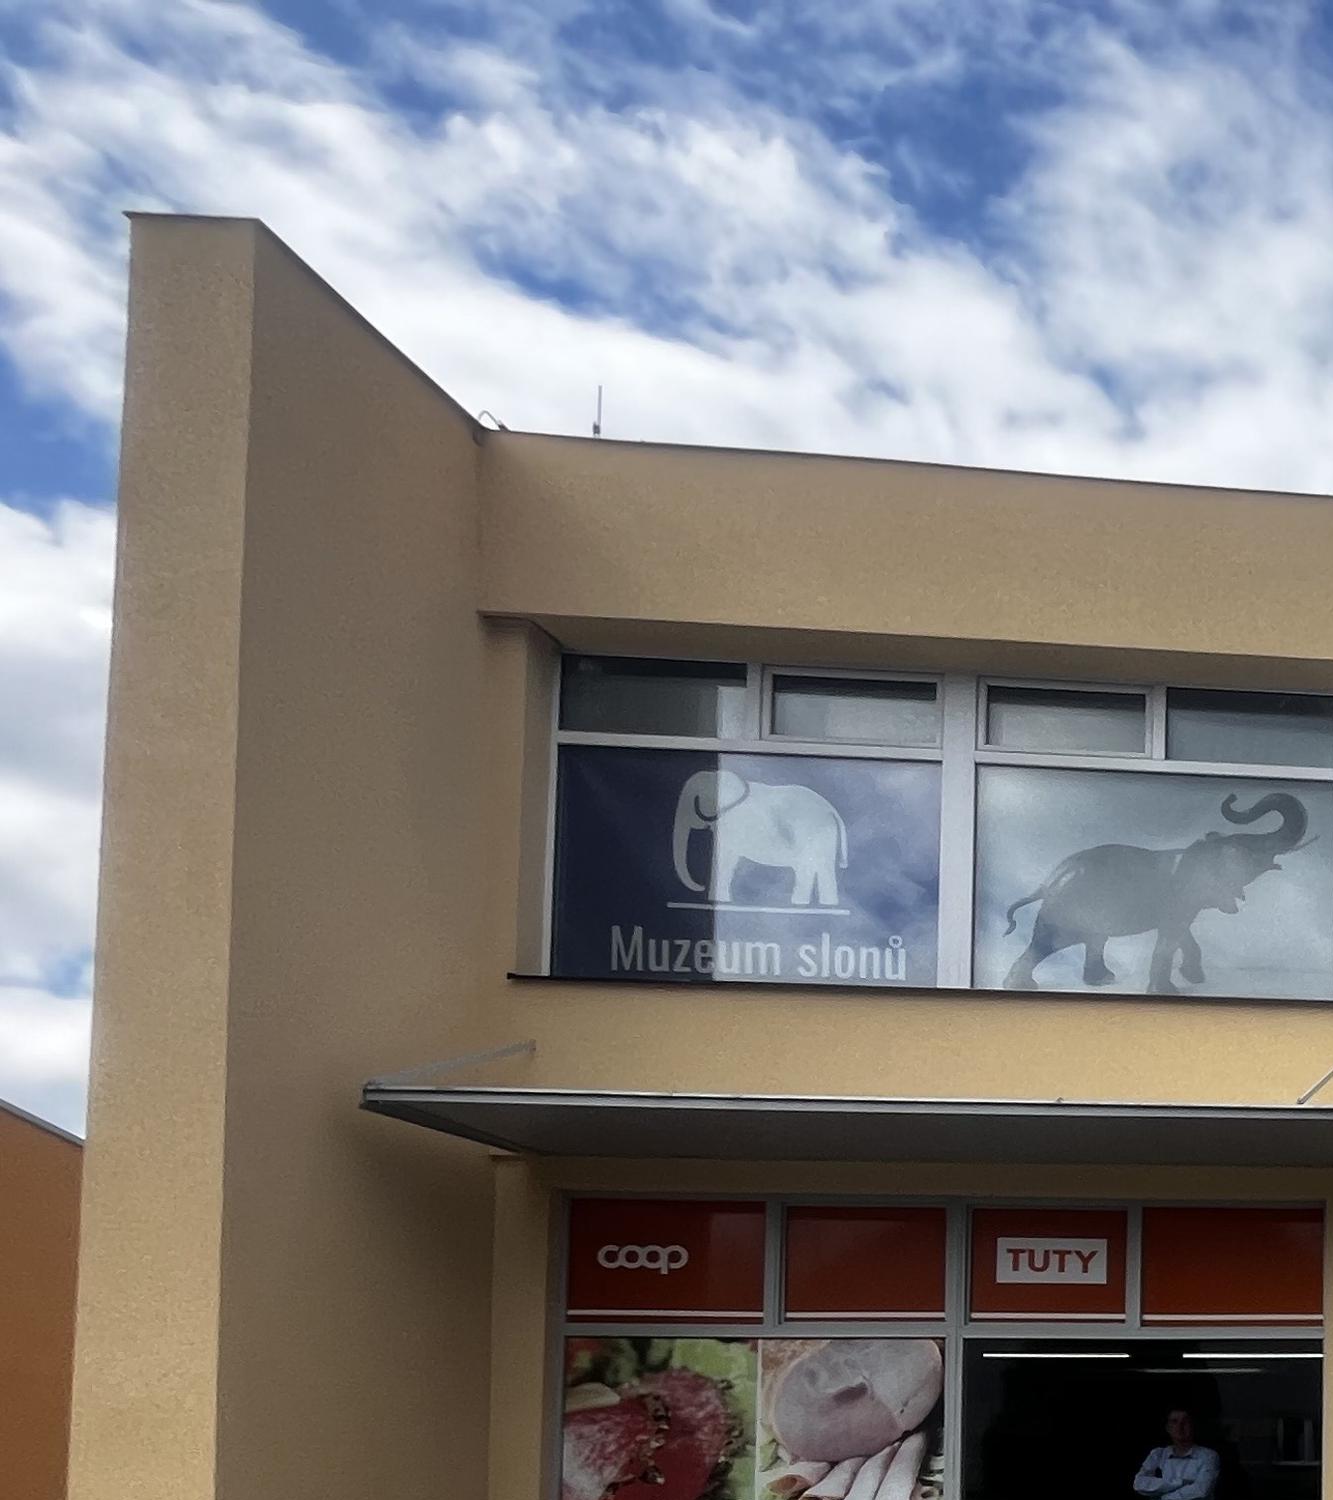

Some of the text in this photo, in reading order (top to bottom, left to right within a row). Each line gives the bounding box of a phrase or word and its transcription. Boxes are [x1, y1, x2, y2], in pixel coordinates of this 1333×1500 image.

[610, 925, 906, 981] Muzeum slonů
[598, 1243, 689, 1275] coop
[1006, 1248, 1098, 1275] TUTY
